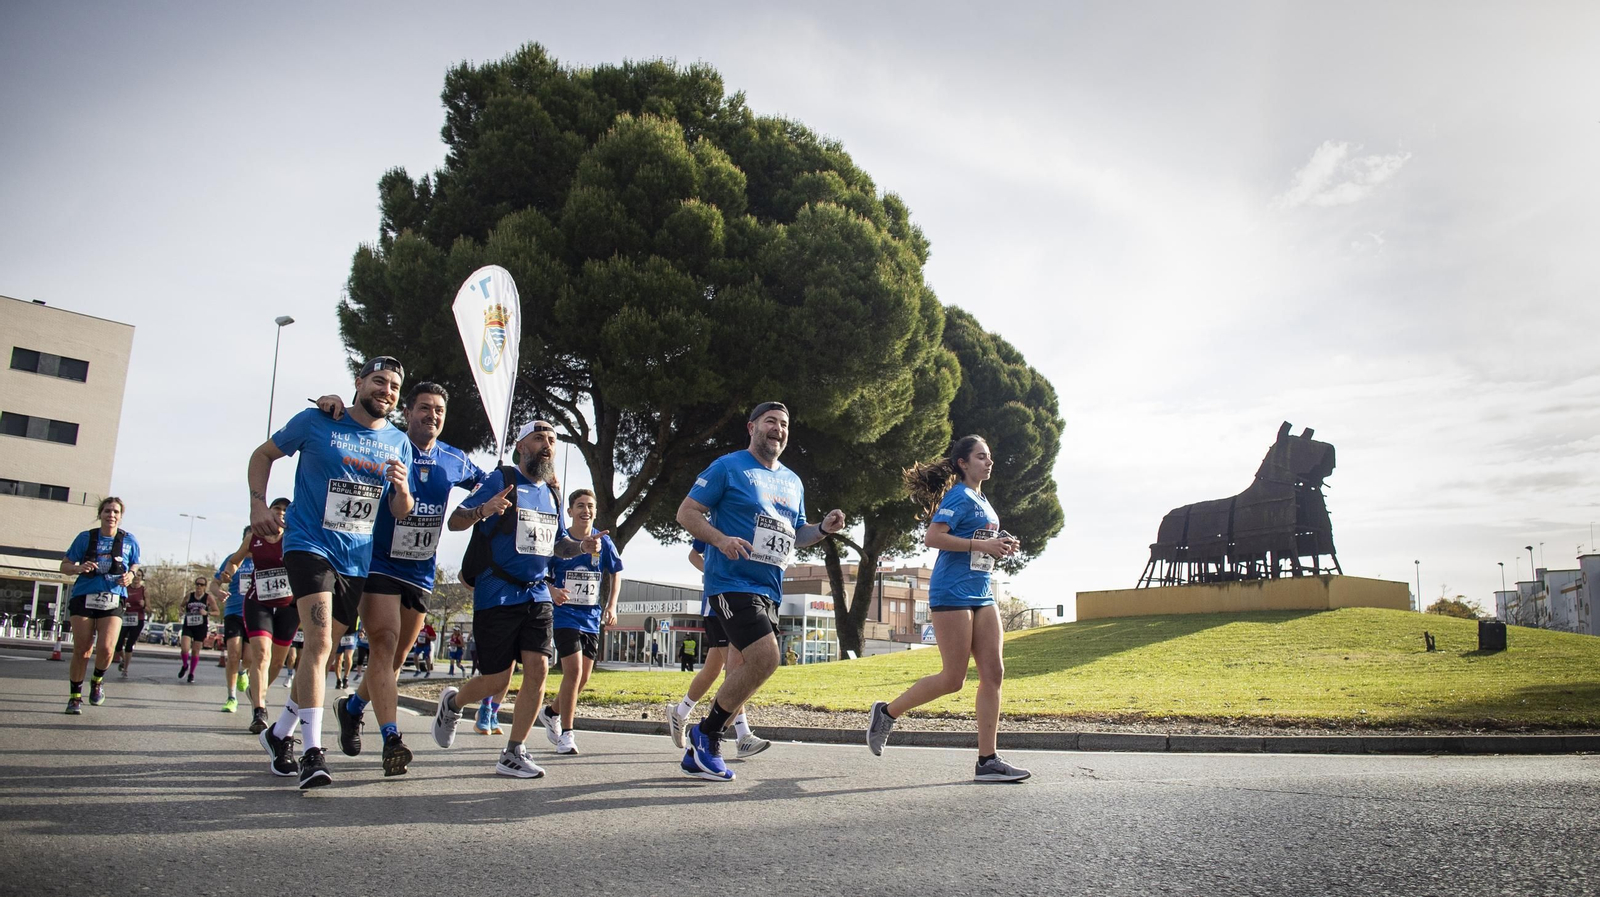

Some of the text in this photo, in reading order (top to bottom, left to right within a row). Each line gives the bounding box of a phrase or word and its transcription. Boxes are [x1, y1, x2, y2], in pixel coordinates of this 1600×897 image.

[331, 440, 399, 461] POPULAR JEREZ
[360, 437, 399, 455] CARRERA
[343, 455, 386, 476] enjoy!
[331, 487, 362, 496] POPULAR
[340, 500, 372, 520] 429
[414, 531, 432, 548] 10
[529, 527, 552, 543] 430
[766, 535, 791, 556] 433
[265, 578, 287, 591] 148
[575, 583, 595, 595] 742
[95, 592, 113, 603] 251
[617, 602, 682, 613] PARRILLA DESDE 1954
